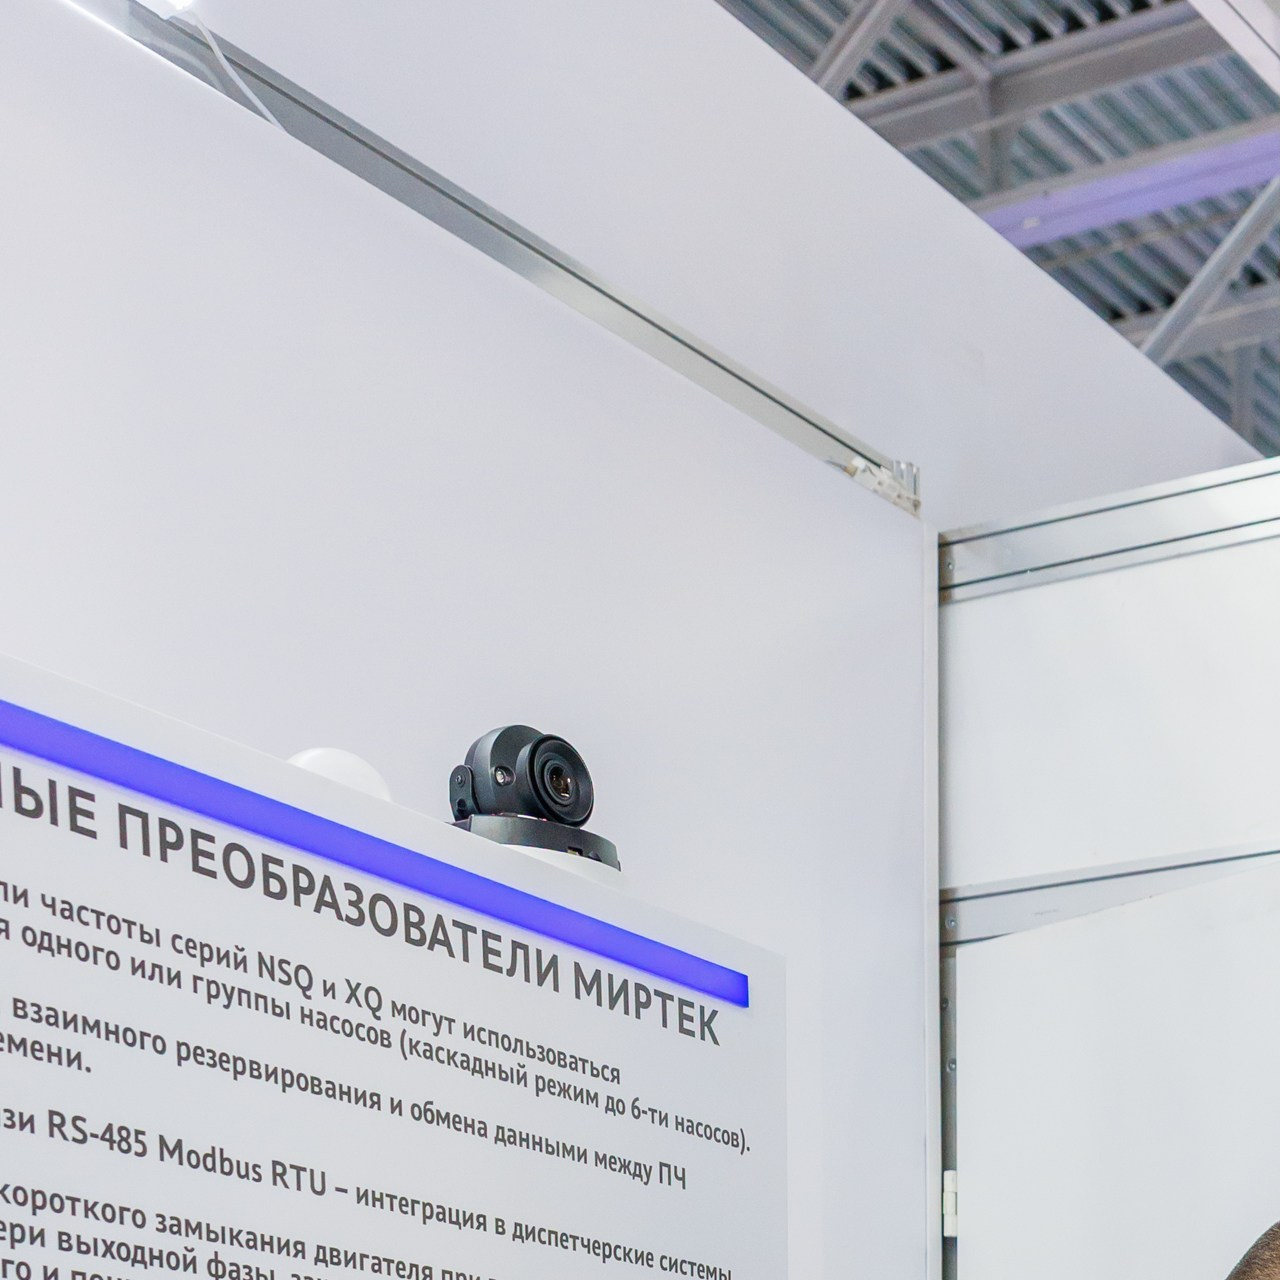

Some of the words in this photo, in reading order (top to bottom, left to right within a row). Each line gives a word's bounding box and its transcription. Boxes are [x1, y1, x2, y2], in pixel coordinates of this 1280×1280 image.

[0, 763, 98, 841] ЫЕ
[117, 802, 560, 993] ПРЕОБРАЗОВАТЕЛИ
[573, 960, 721, 1047] МИРТЕК
[40, 893, 161, 948] частоты
[170, 933, 248, 974] серий
[257, 951, 314, 1001] NSQ
[322, 978, 337, 1001] и
[344, 977, 383, 1022] XQ
[390, 999, 456, 1038] могут
[462, 1021, 621, 1085] использоваться
[12, 997, 167, 1056] взаимного
[176, 1040, 382, 1112] резервирования
[389, 1096, 403, 1117] и
[410, 1100, 488, 1139] обмена
[493, 1124, 588, 1165] данными
[594, 1150, 653, 1186] между
[658, 1161, 687, 1191] ПЧ
[21, 925, 121, 971] одного
[130, 956, 182, 990] или
[192, 974, 291, 1021] группы
[299, 1005, 393, 1049] насосов
[399, 1028, 528, 1088] (каскадный
[534, 1074, 599, 1109] режим
[604, 1094, 626, 1117] до
[630, 1096, 669, 1129] 6-ти
[674, 1114, 751, 1156] насосов).
[2, 1108, 36, 1135] зи
[47, 1109, 148, 1158] RS-485
[158, 1134, 263, 1183] Modbus
[271, 1159, 327, 1197] RTU
[355, 1186, 488, 1233] интеграция
[494, 1217, 507, 1236] в
[511, 1221, 655, 1269] диспетчерские
[57, 1230, 198, 1275] выходной
[155, 1212, 306, 1260] замыкания
